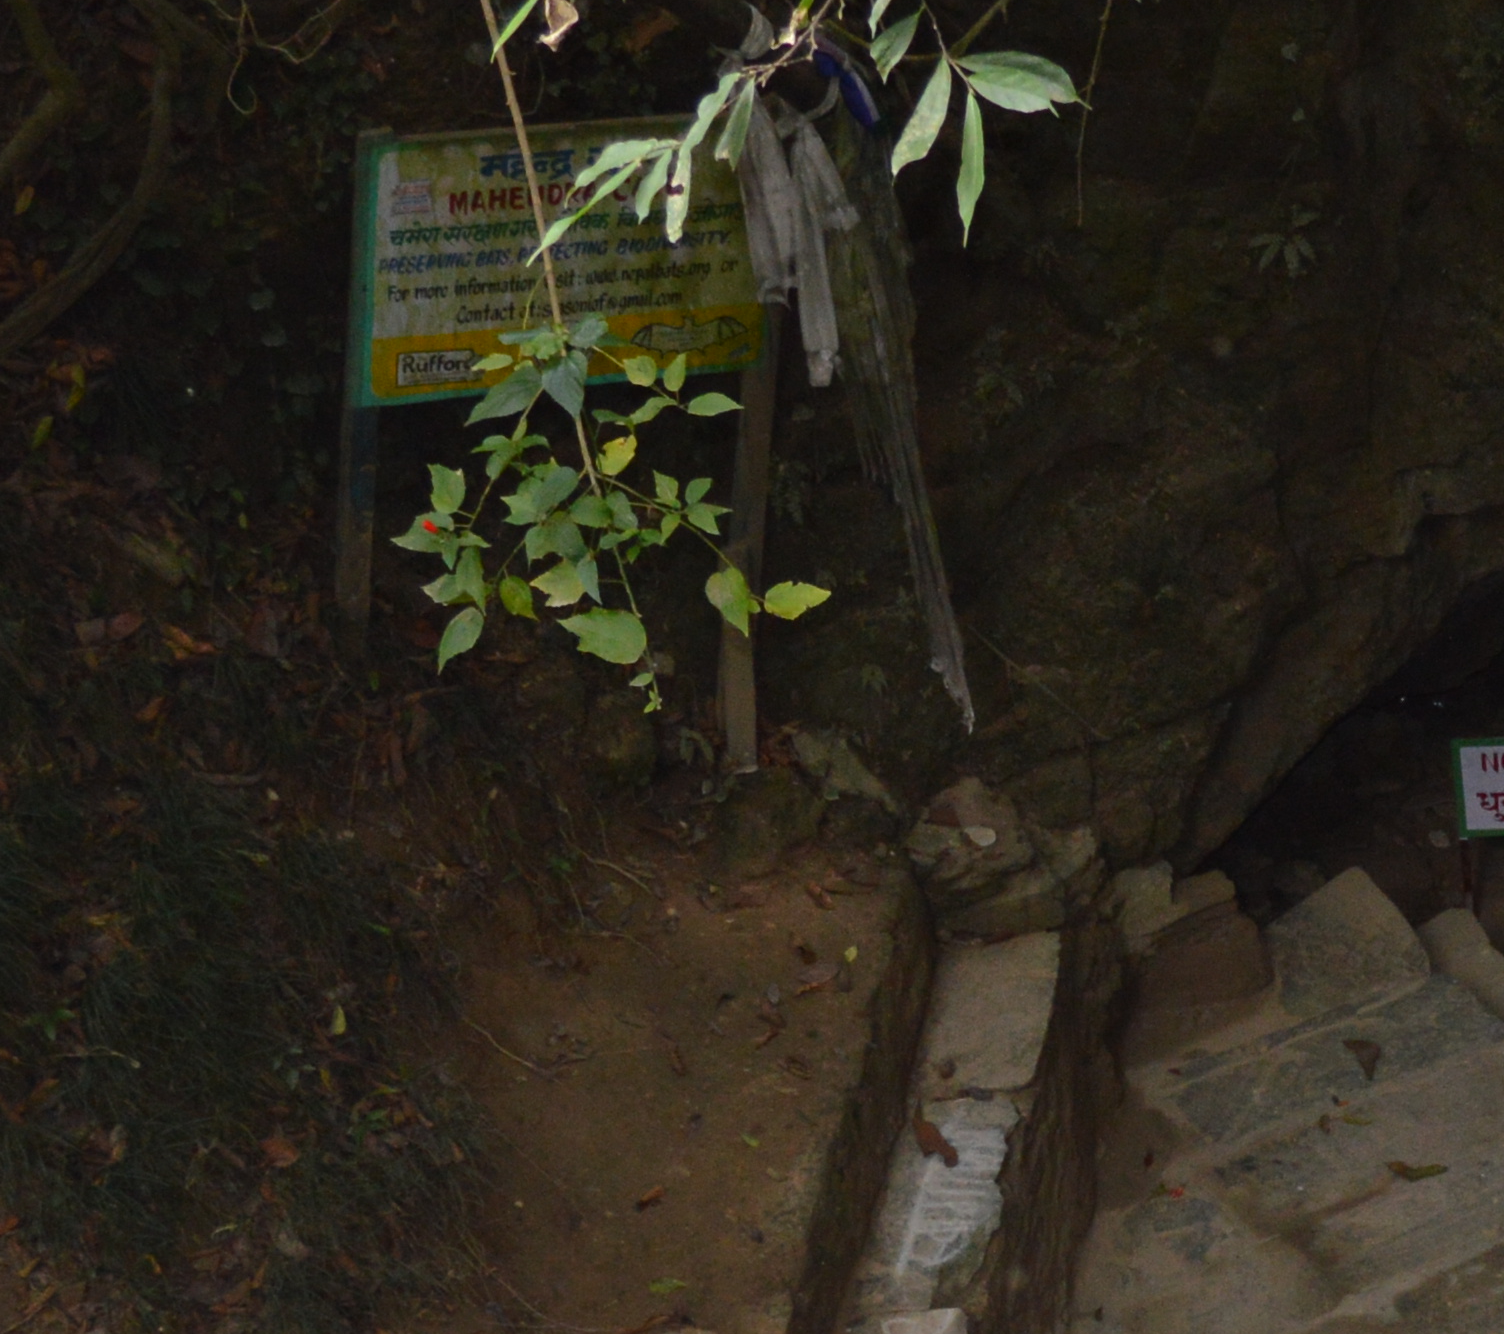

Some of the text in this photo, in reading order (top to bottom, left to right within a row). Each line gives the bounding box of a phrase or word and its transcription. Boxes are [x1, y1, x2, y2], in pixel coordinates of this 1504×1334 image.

[377, 251, 472, 274] PRESERVING
[517, 240, 608, 262] PRECTING
[387, 284, 409, 303] For
[415, 285, 449, 300] more
[455, 274, 536, 297] information
[456, 302, 515, 324] Contact
